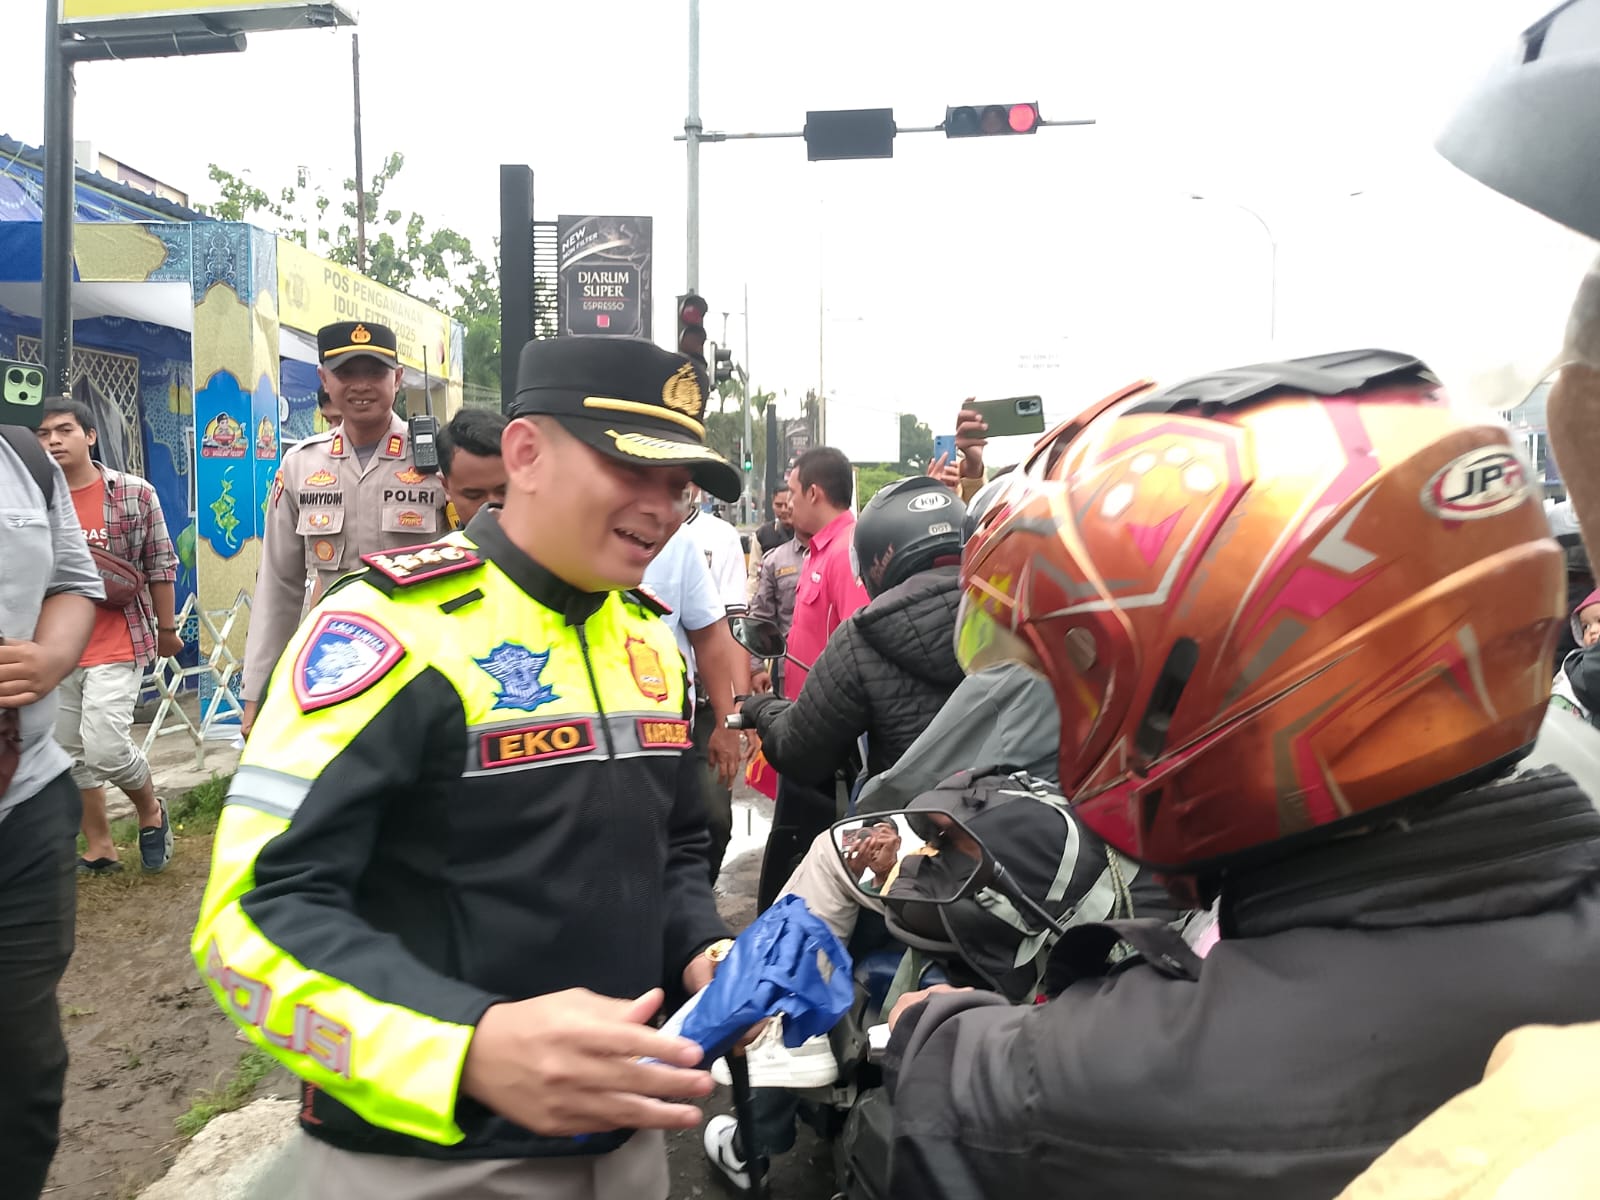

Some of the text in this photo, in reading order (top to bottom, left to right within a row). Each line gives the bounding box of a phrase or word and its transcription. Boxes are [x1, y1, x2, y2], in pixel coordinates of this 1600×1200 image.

[562, 226, 586, 252] NEW
[324, 267, 350, 294] POS
[578, 271, 630, 285] DJARUM
[583, 285, 624, 298] SUPER
[583, 301, 625, 311] ESPRESSO
[333, 294, 361, 320] IDUL
[394, 321, 416, 343] 2025
[383, 489, 435, 504] POLRI
[500, 726, 581, 760] EKO
